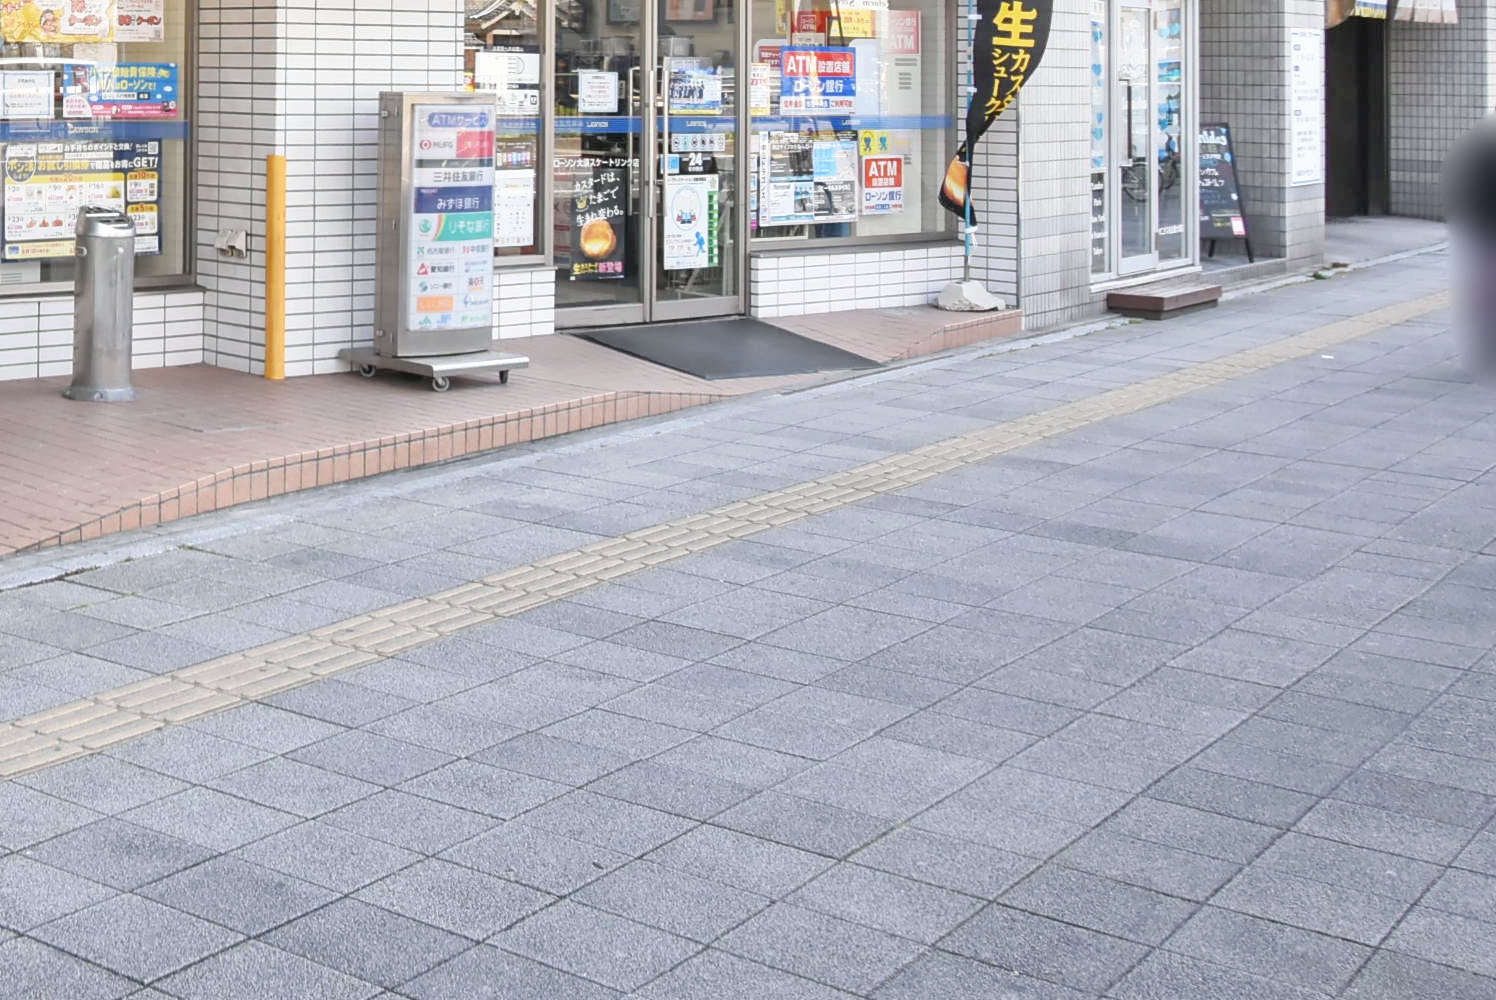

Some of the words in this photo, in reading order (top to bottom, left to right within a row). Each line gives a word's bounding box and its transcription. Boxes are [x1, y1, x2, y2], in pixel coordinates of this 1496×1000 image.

[991, 0, 1038, 49] 生
[786, 54, 817, 73] ATM
[688, 153, 704, 167] 24
[868, 160, 898, 177] ATM
